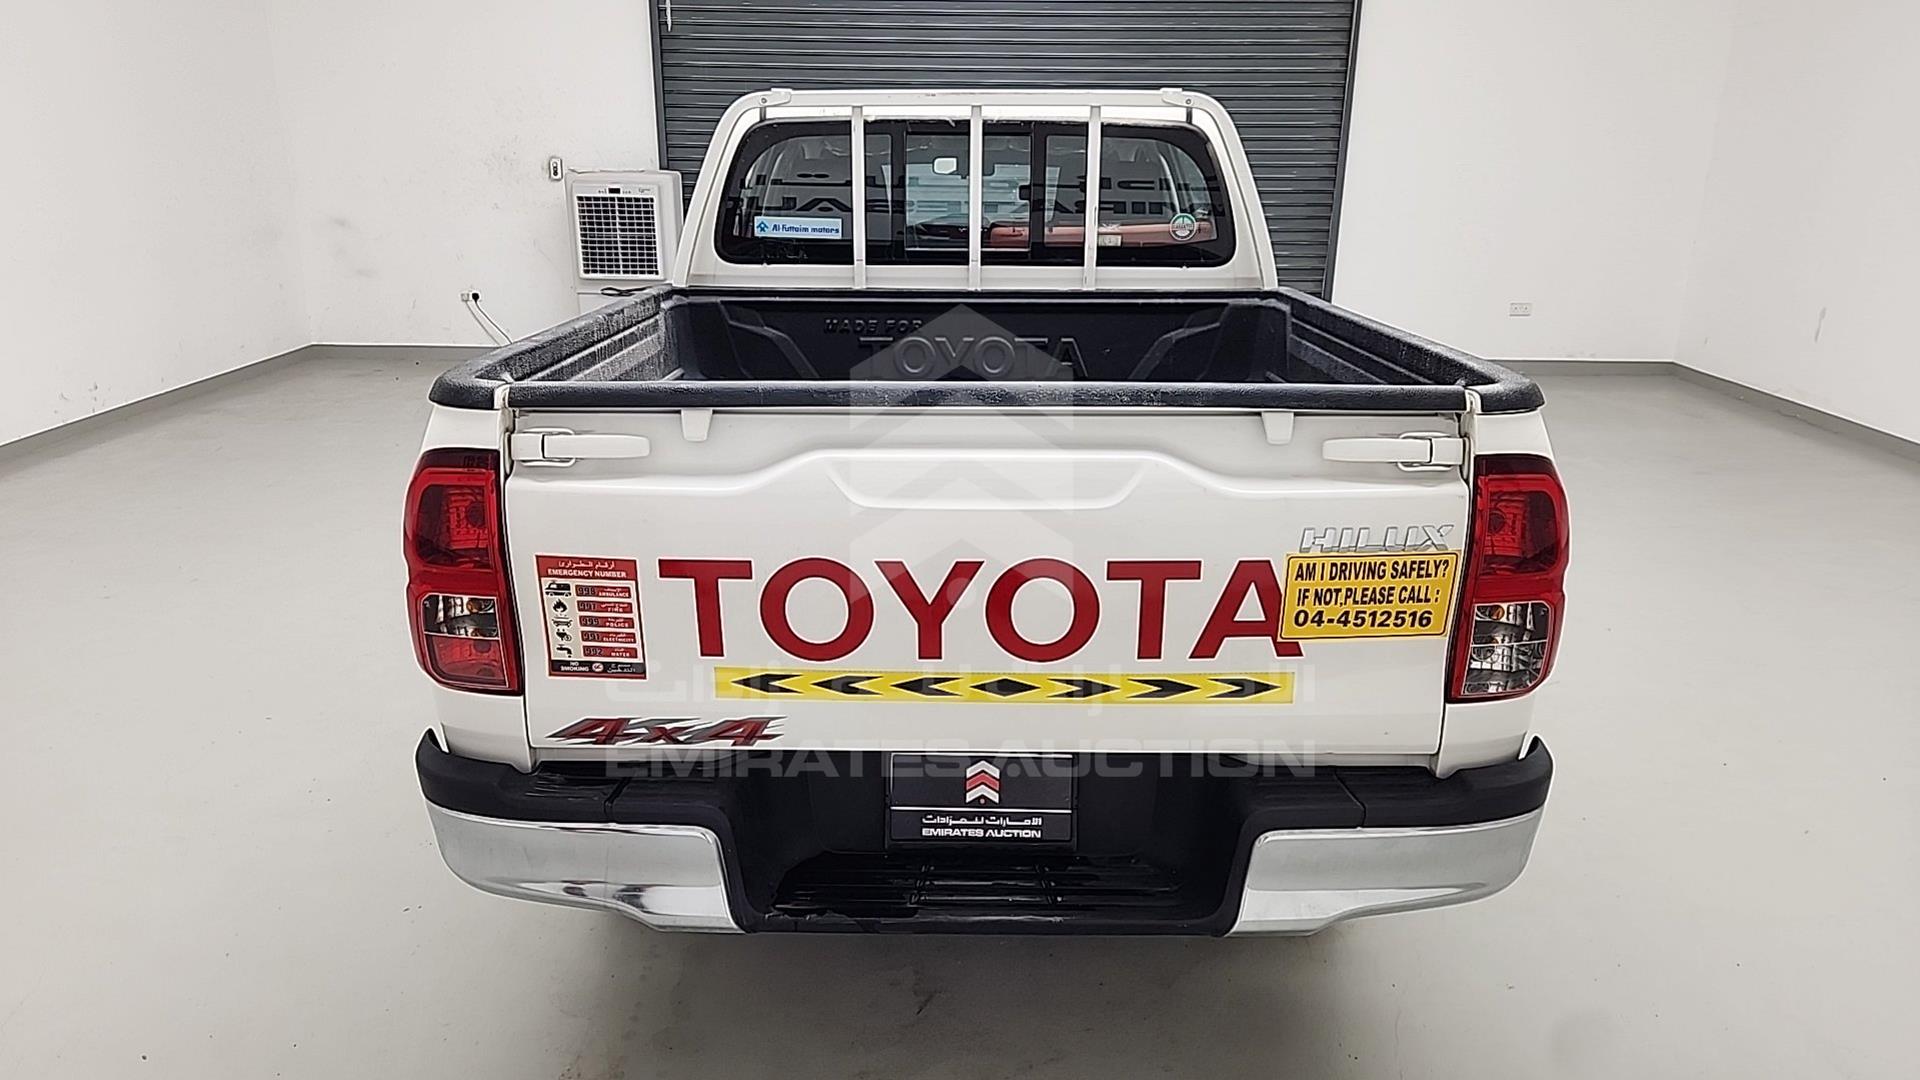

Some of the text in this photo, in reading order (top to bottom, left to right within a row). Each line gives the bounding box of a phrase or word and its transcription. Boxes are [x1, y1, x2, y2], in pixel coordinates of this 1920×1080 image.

[811, 226, 840, 234] motors
[824, 319, 922, 333] MADE FOR
[858, 335, 1089, 381] TOYOTA
[1299, 524, 1454, 553] HILUX
[547, 569, 627, 578] EMERGENCY NUMBER
[1295, 563, 1317, 581] AM
[1329, 561, 1387, 580] DRIVING
[1390, 559, 1450, 579] SAFELY?
[1297, 588, 1310, 606] IF
[1398, 585, 1430, 603] CALL
[658, 558, 1304, 661] TOYOTA
[1294, 610, 1433, 628] 04-4512516
[922, 828, 1041, 838] EMIRATES AUCTION
